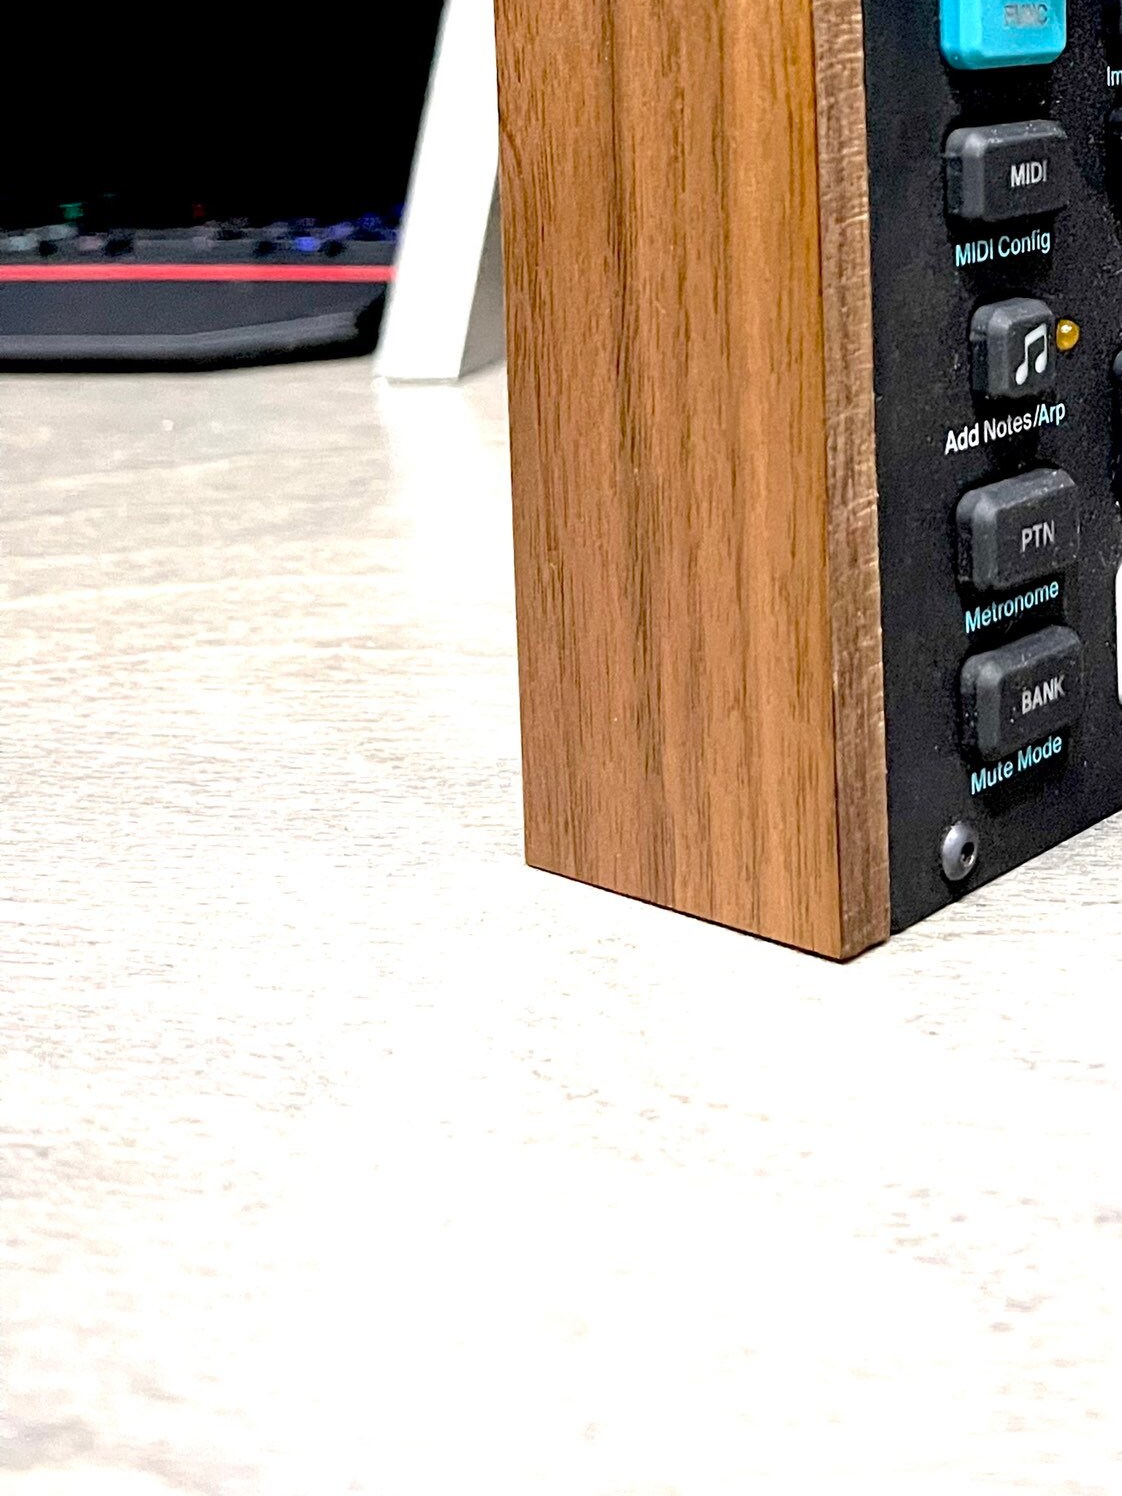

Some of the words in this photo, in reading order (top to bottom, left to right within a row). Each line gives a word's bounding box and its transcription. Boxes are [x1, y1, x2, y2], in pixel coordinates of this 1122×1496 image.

[1010, 159, 1048, 188] MIDI
[955, 238, 995, 268] MIDI
[997, 230, 1051, 258] Config
[944, 422, 980, 456] Add
[983, 402, 1067, 444] Notes/Arp
[1021, 521, 1055, 553] PTN
[964, 580, 1059, 635] Metronome
[1021, 674, 1065, 715] BANK
[970, 758, 1014, 796] Mute
[1017, 735, 1063, 774] Mode
